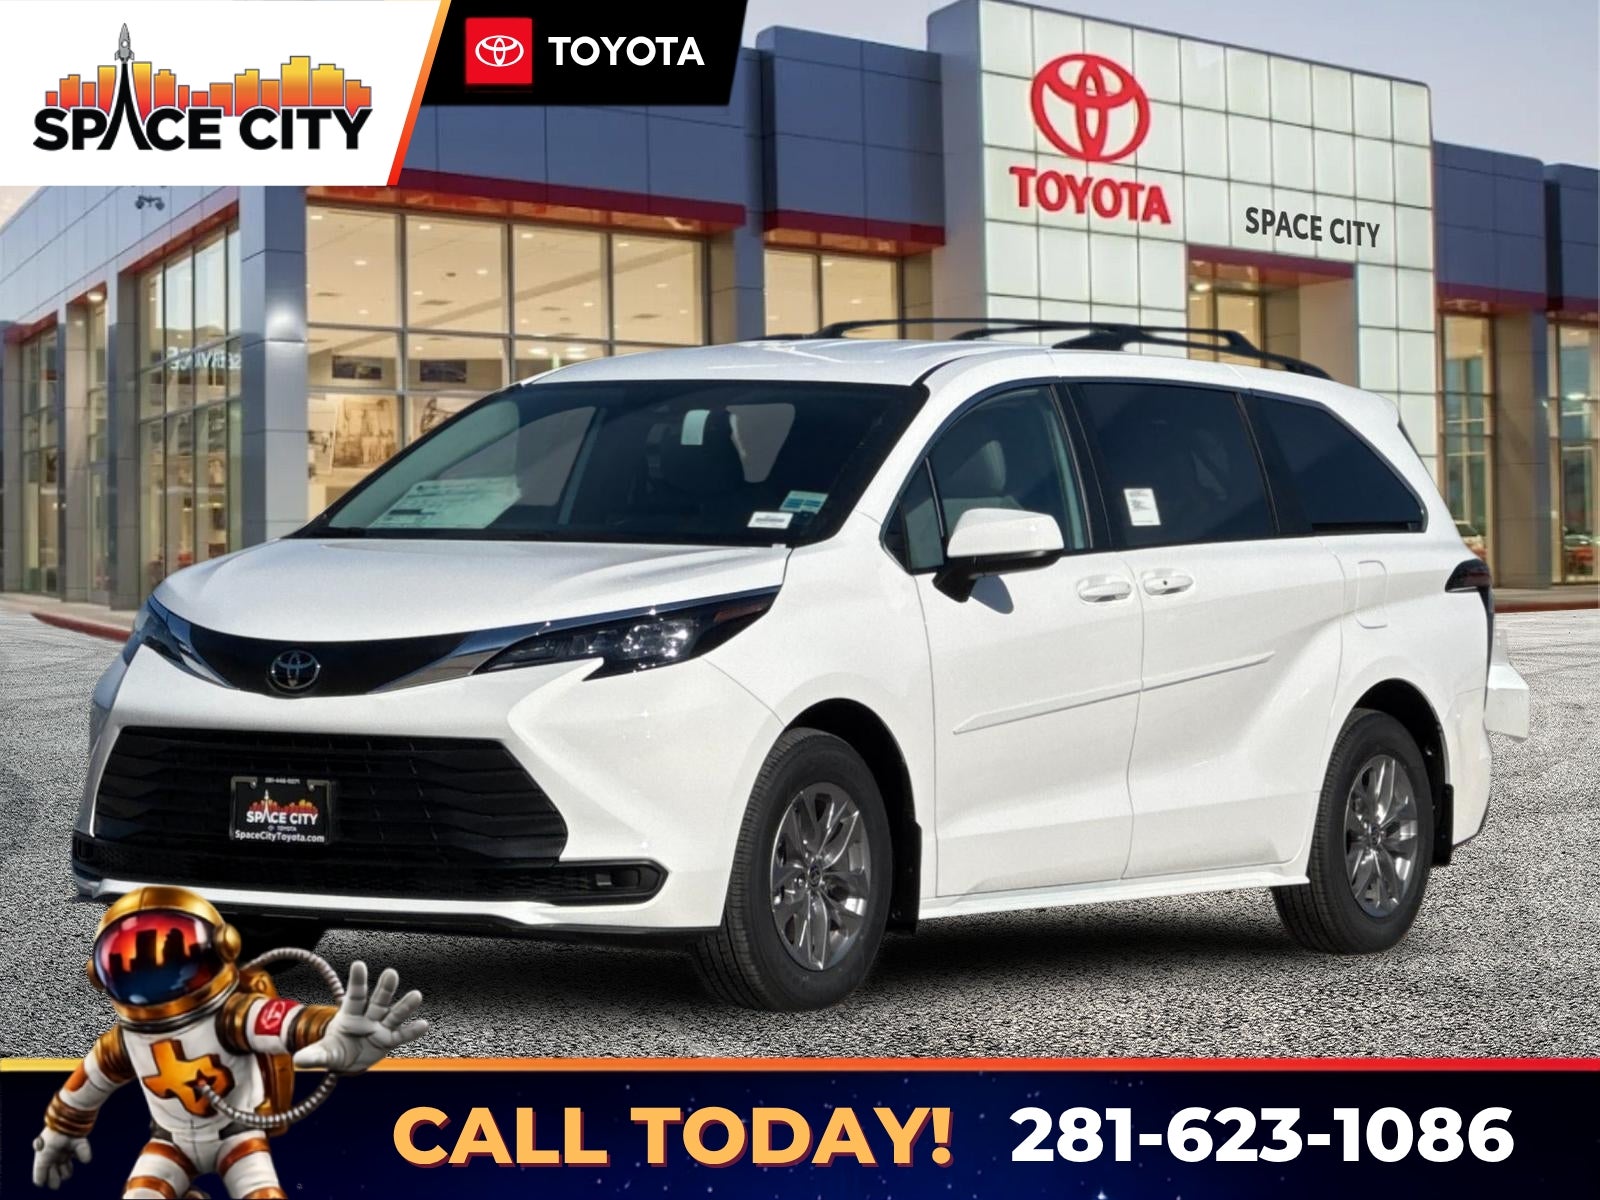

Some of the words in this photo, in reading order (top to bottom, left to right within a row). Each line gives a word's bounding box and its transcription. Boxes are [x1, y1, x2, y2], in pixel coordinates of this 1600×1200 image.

[1008, 166, 1171, 224] TOYOTA
[1245, 206, 1323, 241] SPACE
[1329, 218, 1380, 248] CITY
[289, 812, 318, 825] CITY
[234, 829, 325, 843] SpaceCityToyota.com
